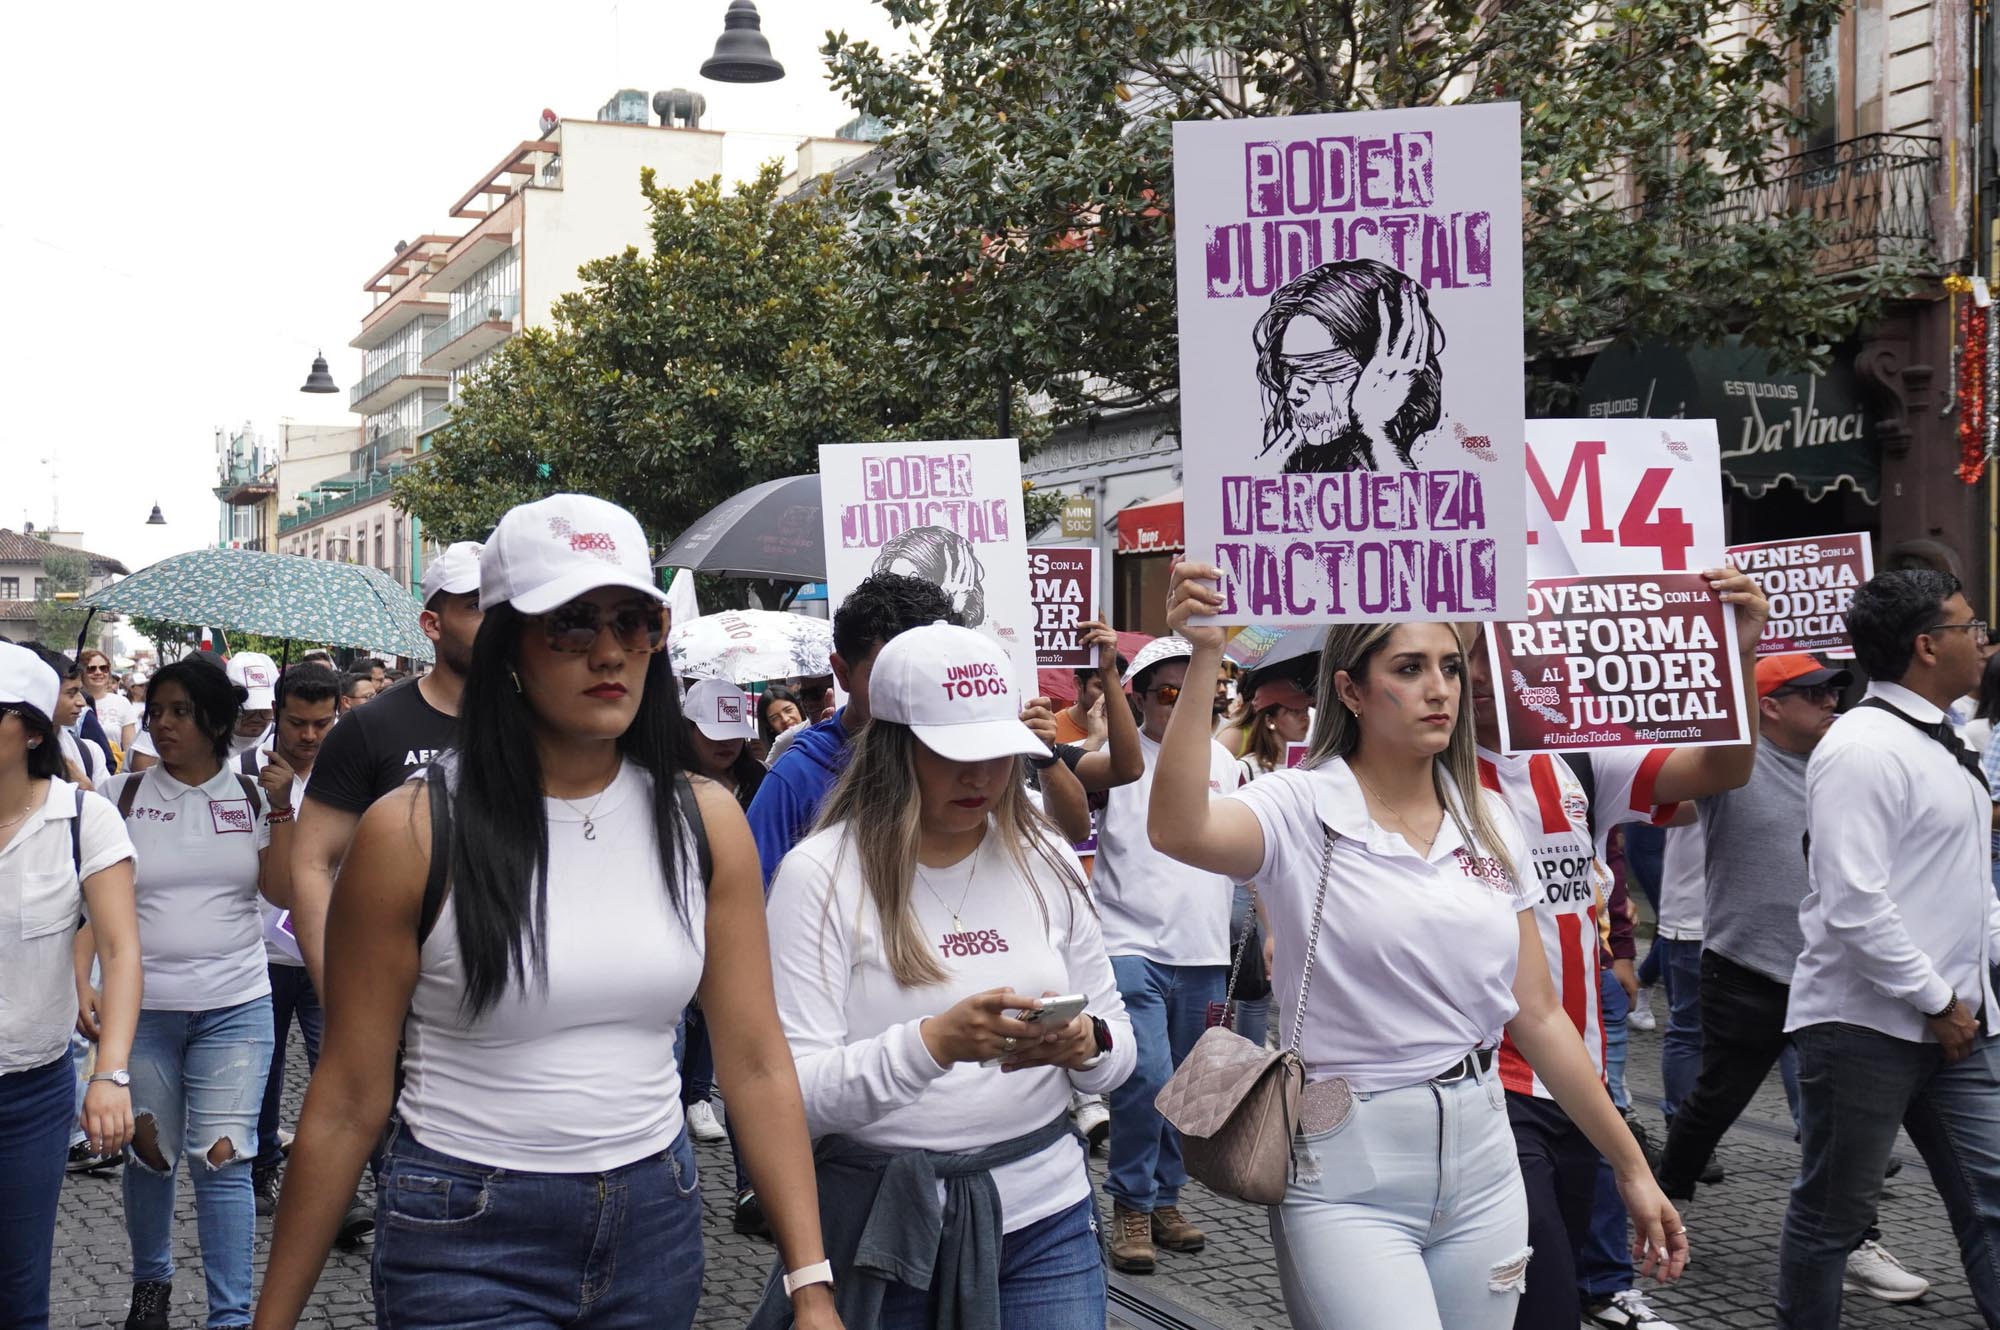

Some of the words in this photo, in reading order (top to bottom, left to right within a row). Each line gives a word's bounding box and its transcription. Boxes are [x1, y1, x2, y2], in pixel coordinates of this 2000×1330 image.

[1245, 131, 1434, 217] PODER
[1724, 380, 1799, 399] ESTUDIOS
[1589, 398, 1639, 417] ESTUDIOS
[862, 453, 973, 501] PODER
[1066, 507, 1091, 518] MINI
[568, 541, 616, 551] TODOS
[1821, 548, 1840, 558] CON
[1842, 547, 1855, 555] LA
[1051, 562, 1070, 570] CON
[1072, 562, 1084, 570] LA
[1216, 538, 1496, 616] NACIONAL
[1664, 592, 1691, 603] CON
[1693, 591, 1711, 602] LA
[1507, 616, 1719, 656] REFORMA
[1793, 637, 1843, 648] #ReformaYa
[946, 663, 999, 681] UNIDOS
[1542, 668, 1564, 682] AL
[1565, 652, 1722, 693] PODER
[942, 678, 1008, 701] TODOS
[1521, 694, 1560, 705] TODOS
[1569, 691, 1728, 730] JUDICIAL
[1543, 730, 1622, 744] #UnidosTodos
[1635, 727, 1702, 741] #ReformaYa
[1460, 866, 1506, 880] TODOS
[943, 929, 999, 945] UNIDOS
[939, 939, 1009, 958] TODOS
